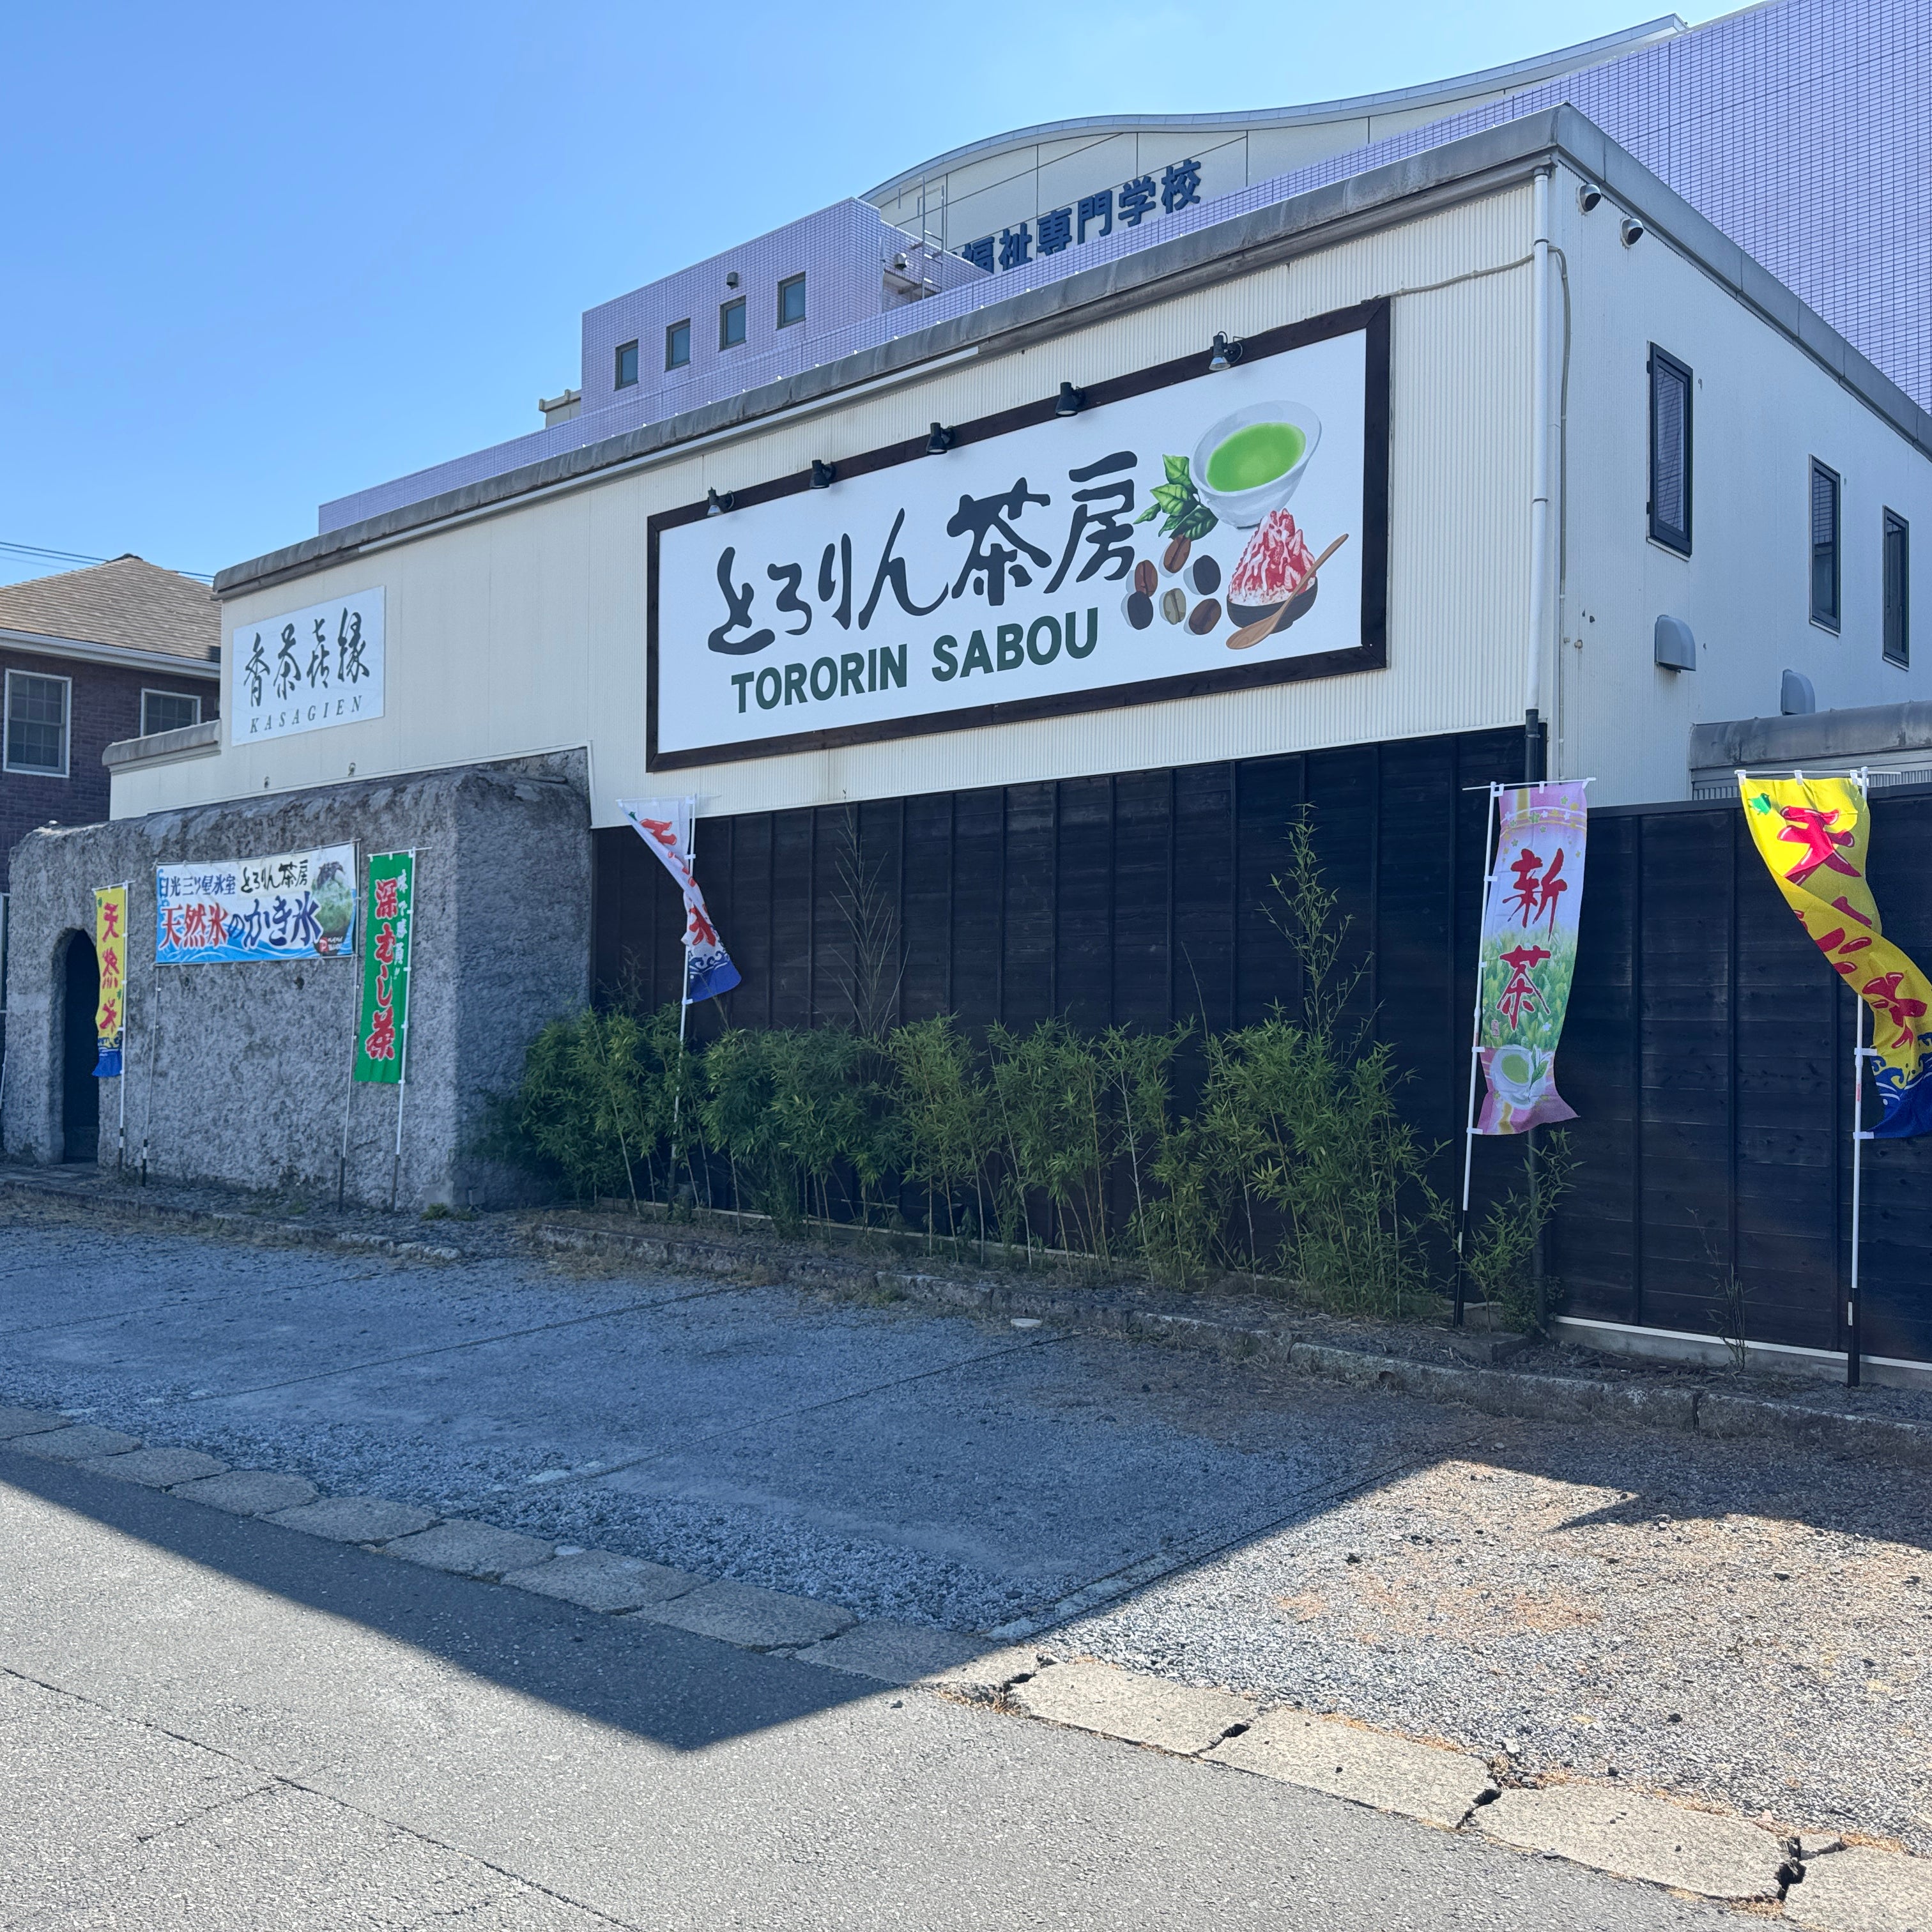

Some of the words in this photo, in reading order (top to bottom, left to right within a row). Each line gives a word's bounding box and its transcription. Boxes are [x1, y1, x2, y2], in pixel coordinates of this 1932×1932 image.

[707, 450, 1138, 656] とろりん茶房
[250, 694, 362, 733] KASAGIEN
[731, 643, 908, 714] TORORIN
[931, 607, 1099, 682] SABOU
[159, 891, 322, 949] 天然氷のかき氷
[365, 879, 399, 1062] 深むし茶
[1496, 847, 1568, 1031] 新茶
